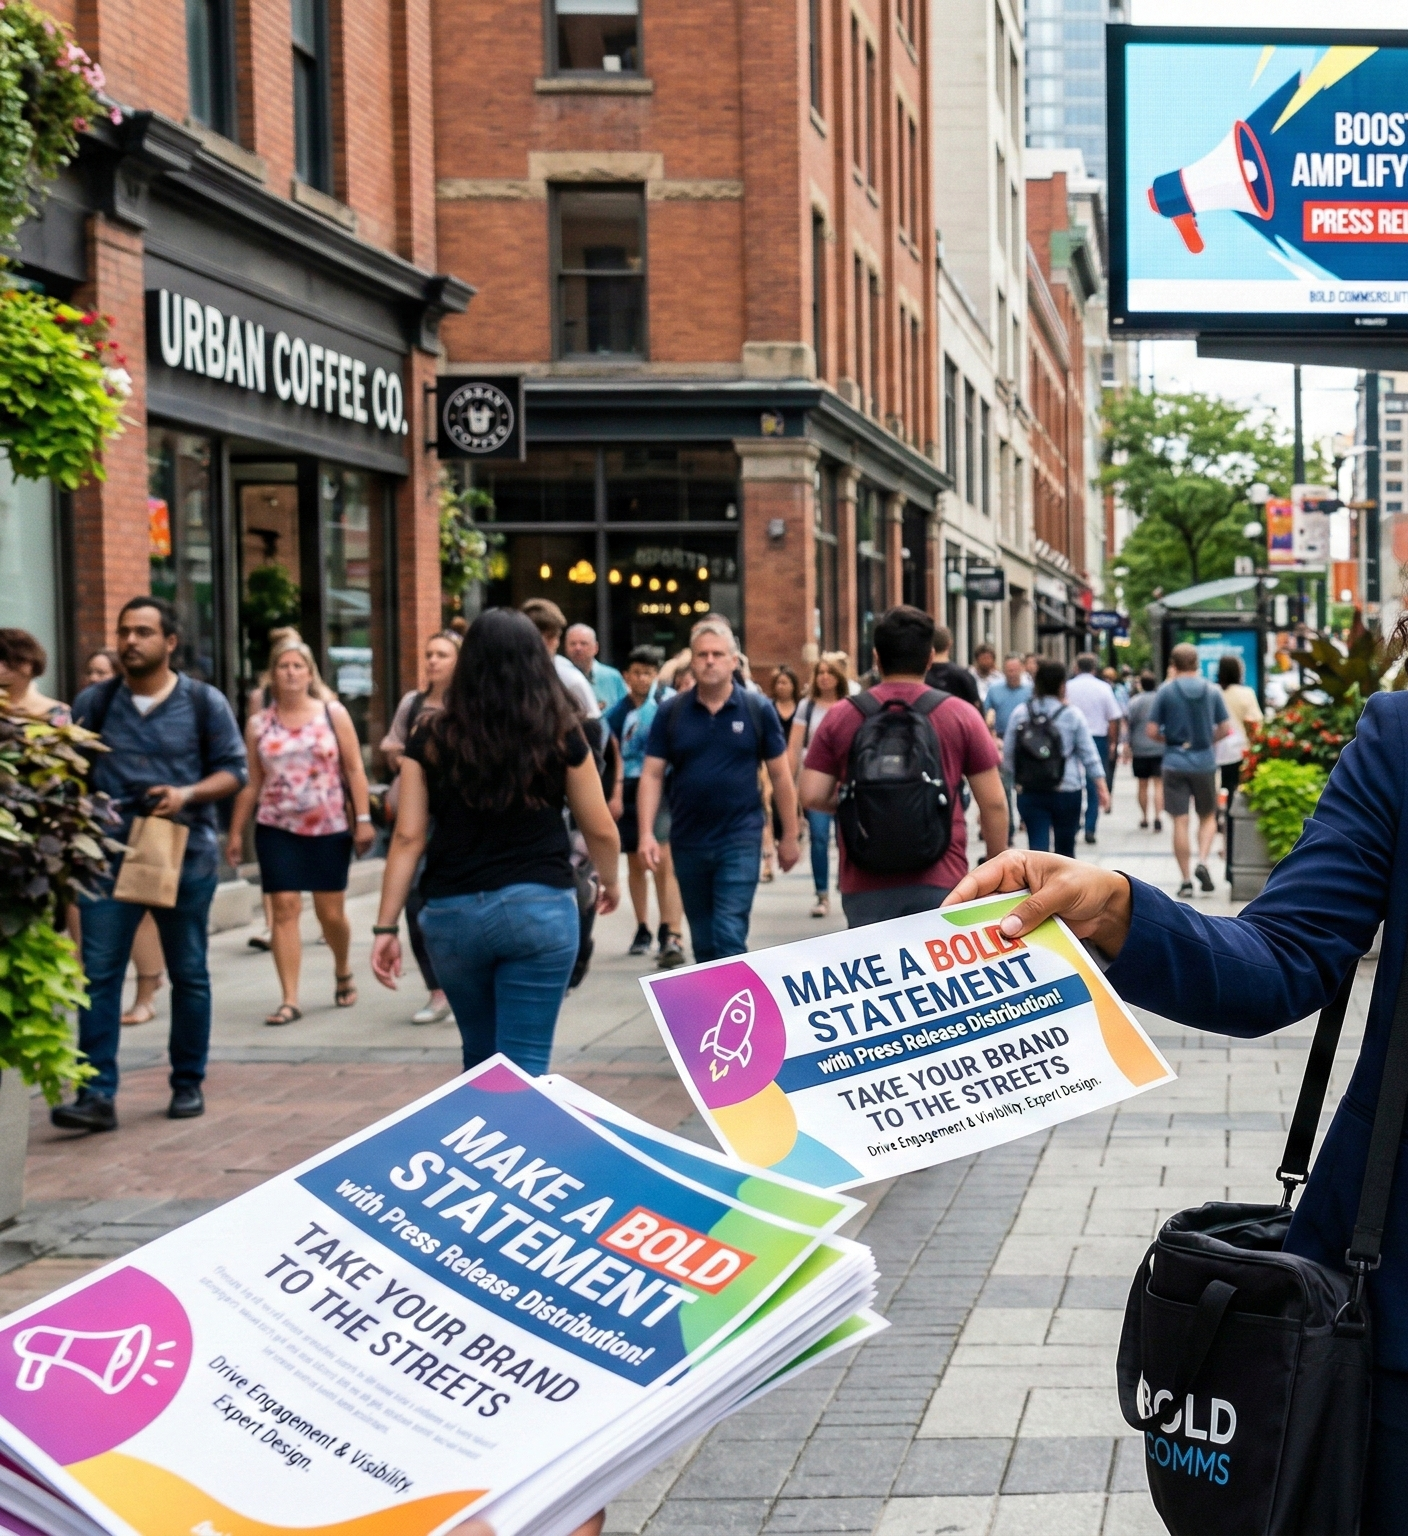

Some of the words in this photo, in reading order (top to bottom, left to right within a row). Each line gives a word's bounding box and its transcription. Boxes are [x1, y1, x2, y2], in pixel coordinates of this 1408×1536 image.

[1311, 208, 1375, 235] PRESS
[160, 288, 267, 393] URBAN
[273, 331, 369, 424] COFFEE
[372, 367, 409, 436] CO.
[781, 953, 893, 1007] MAKE
[898, 947, 926, 981] A
[807, 952, 1038, 1043] STATEMENT
[817, 1052, 855, 1075] with
[854, 1037, 904, 1066] Press
[905, 1023, 967, 1052] Release
[966, 988, 1064, 1033] Distribution!
[837, 1076, 910, 1112] TAKE
[907, 1055, 983, 1091] YOUR
[982, 1026, 1070, 1070] BRAND
[866, 1106, 905, 1133] TO
[904, 1090, 961, 1123] THE
[961, 1055, 1070, 1105] STREETS
[867, 1141, 898, 1157] Drive
[1060, 1077, 1102, 1098] Design.
[389, 1151, 700, 1328] STATEMENT
[440, 1115, 586, 1213] MAKE
[560, 1196, 615, 1235] A
[605, 1211, 741, 1287] BOLD
[294, 1221, 384, 1291] TAKE
[375, 1278, 467, 1346] YOUR
[459, 1333, 580, 1403] BRAND
[335, 1178, 386, 1216] with
[378, 1206, 441, 1254] Press
[435, 1244, 520, 1302] Release
[515, 1289, 656, 1367] Distribution!
[264, 1253, 315, 1295] TO
[309, 1286, 380, 1342] THE
[369, 1331, 511, 1418] STREETS
[208, 1355, 249, 1389] Drive
[246, 1383, 339, 1450] Engagement
[334, 1442, 351, 1457] &
[212, 1394, 263, 1436] Expert
[259, 1428, 313, 1473] Design.
[1146, 1431, 1231, 1485] COMMS
